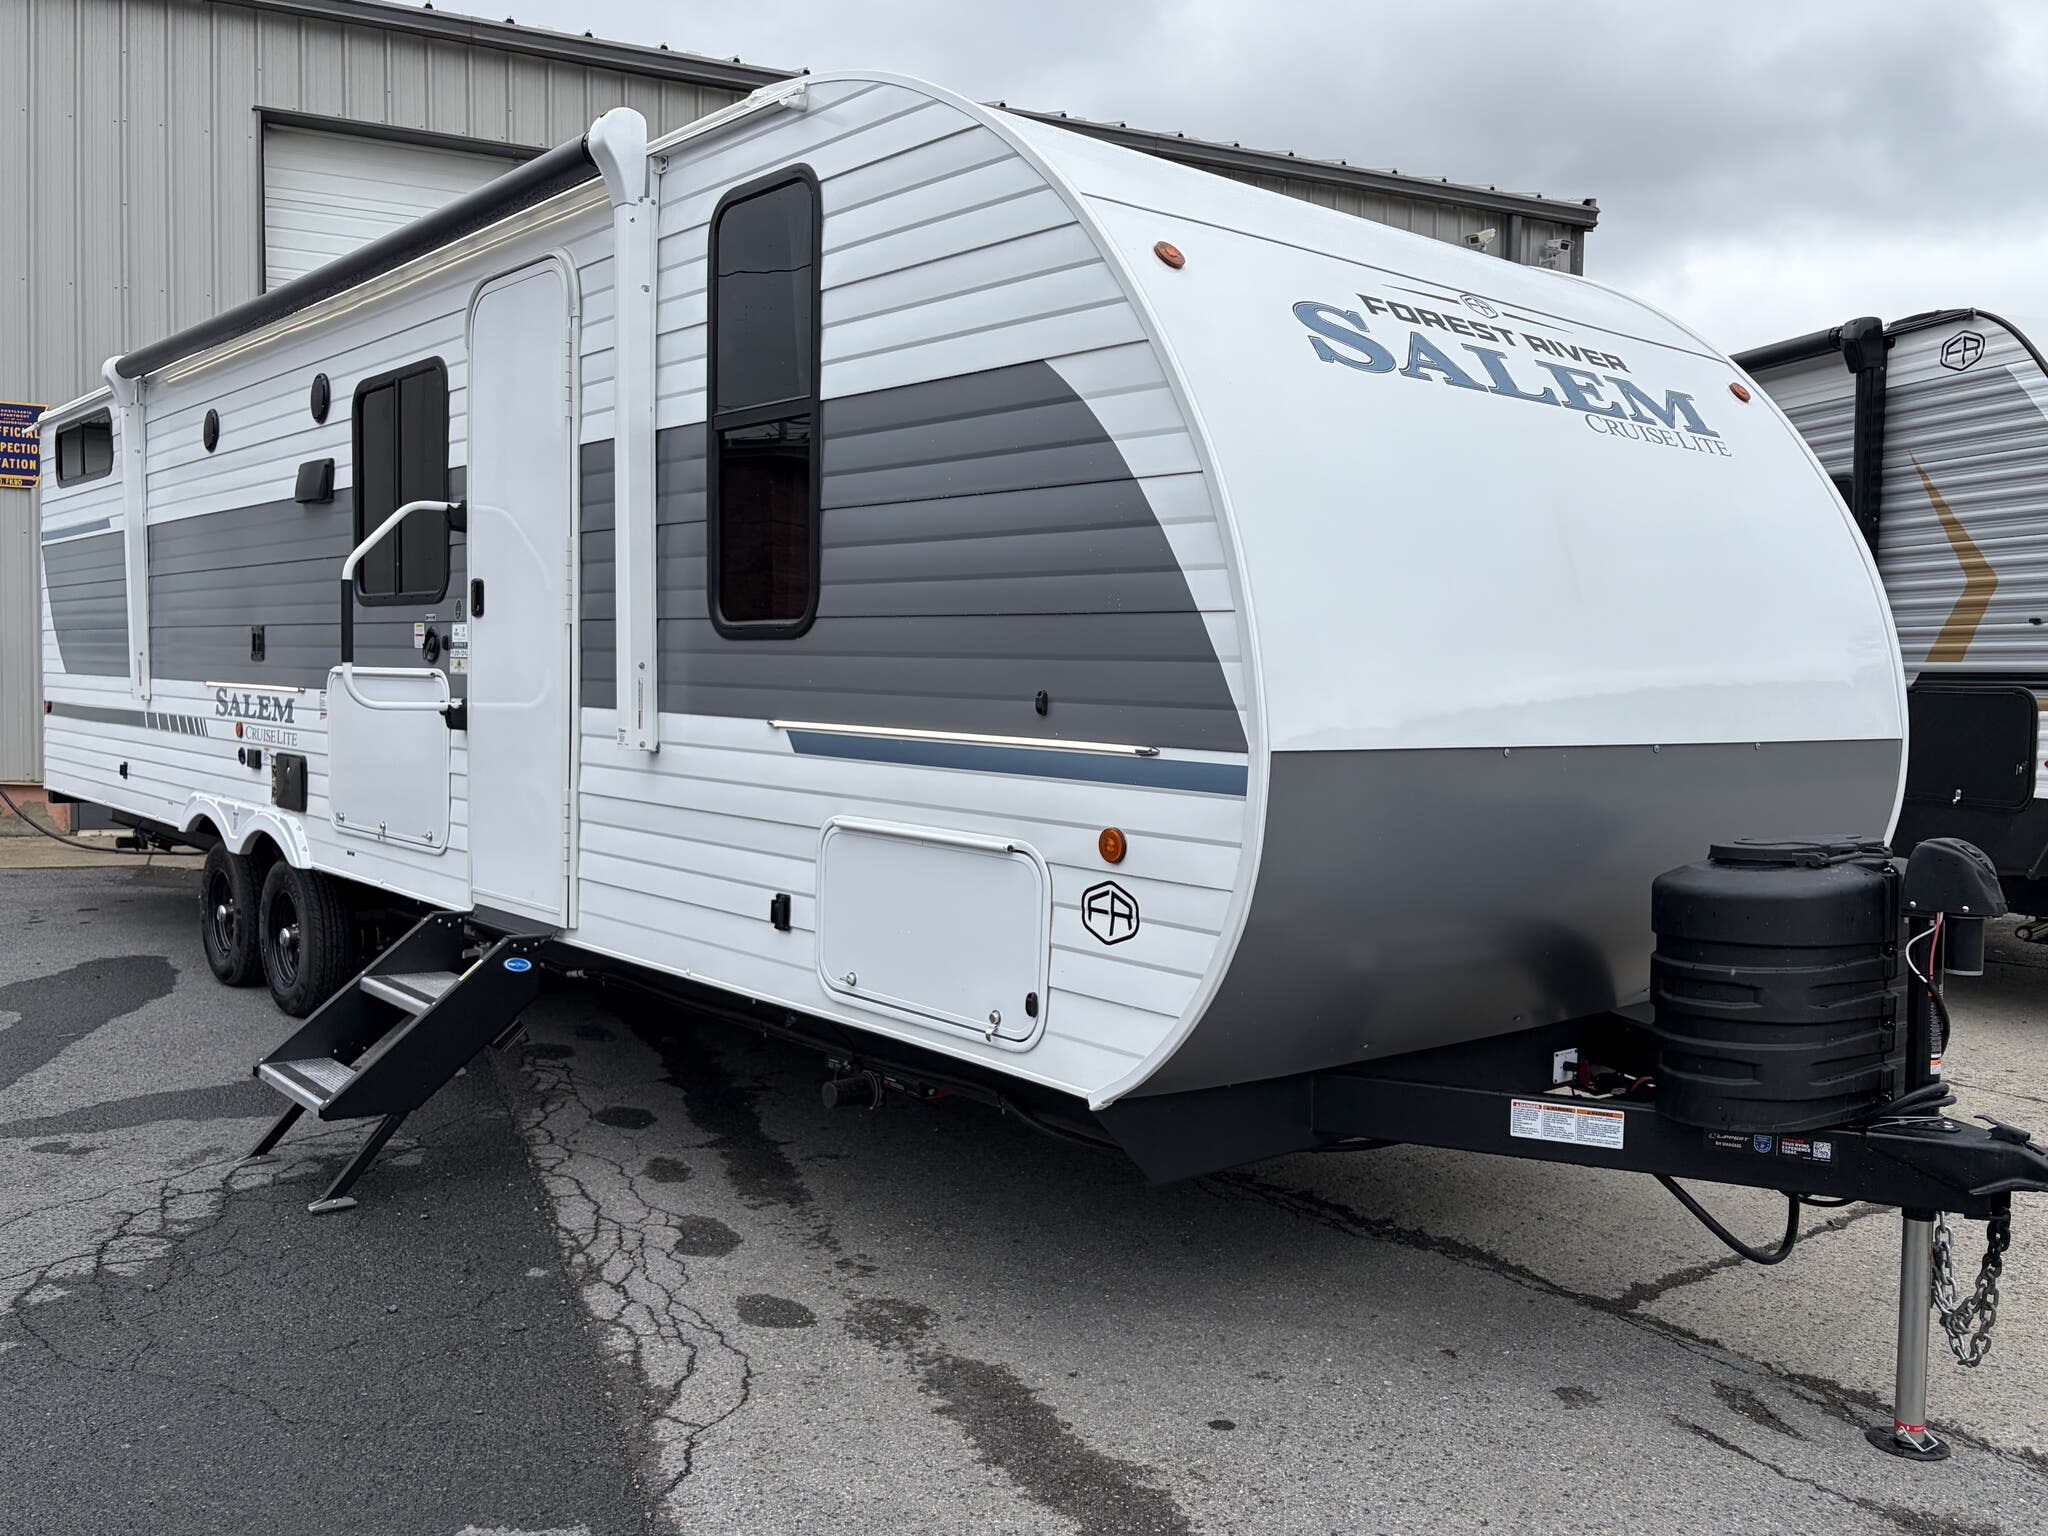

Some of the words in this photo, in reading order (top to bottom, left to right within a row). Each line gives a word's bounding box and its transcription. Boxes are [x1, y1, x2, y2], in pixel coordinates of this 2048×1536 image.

[1356, 293, 1517, 347] FOREST
[1520, 333, 1632, 374] RIVER
[1292, 301, 1720, 438] SALEM
[0, 426, 40, 439] FICIAL
[0, 458, 36, 470] ATION
[216, 687, 295, 724] SALEM
